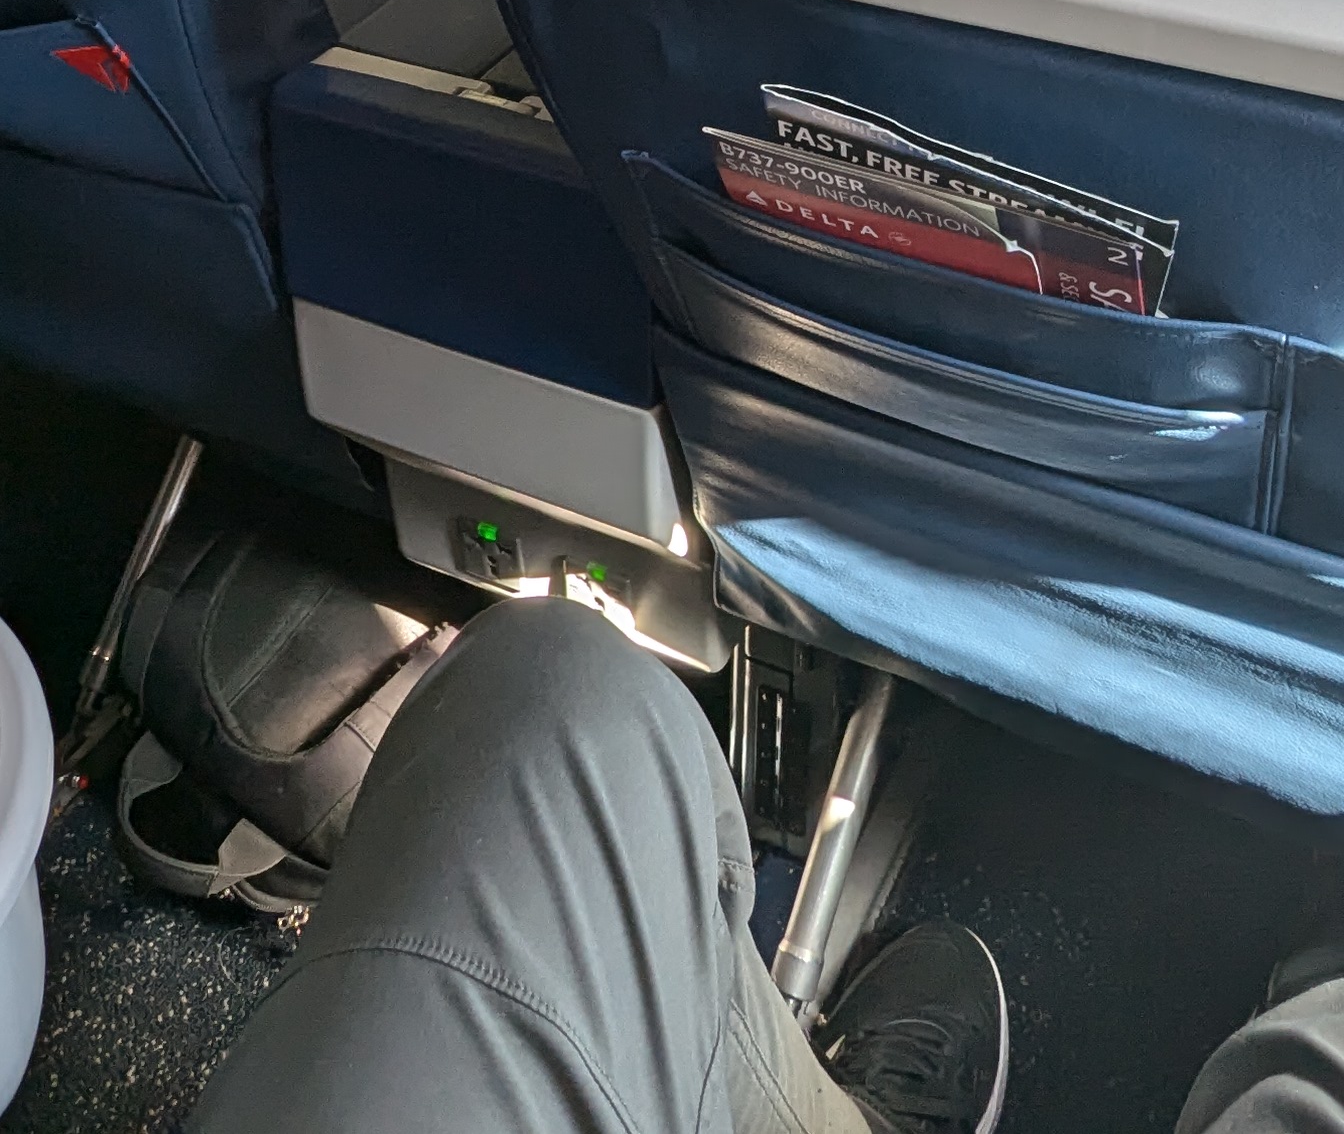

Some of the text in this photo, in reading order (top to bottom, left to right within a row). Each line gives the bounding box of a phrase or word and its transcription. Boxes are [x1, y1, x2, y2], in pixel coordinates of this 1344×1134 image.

[777, 119, 860, 164] FAST,
[811, 109, 897, 147] CONNEC
[719, 142, 866, 195] B737-900ER
[726, 159, 801, 190] SAFETY
[815, 184, 980, 237] INFORMATION
[775, 199, 879, 239] DELTA
